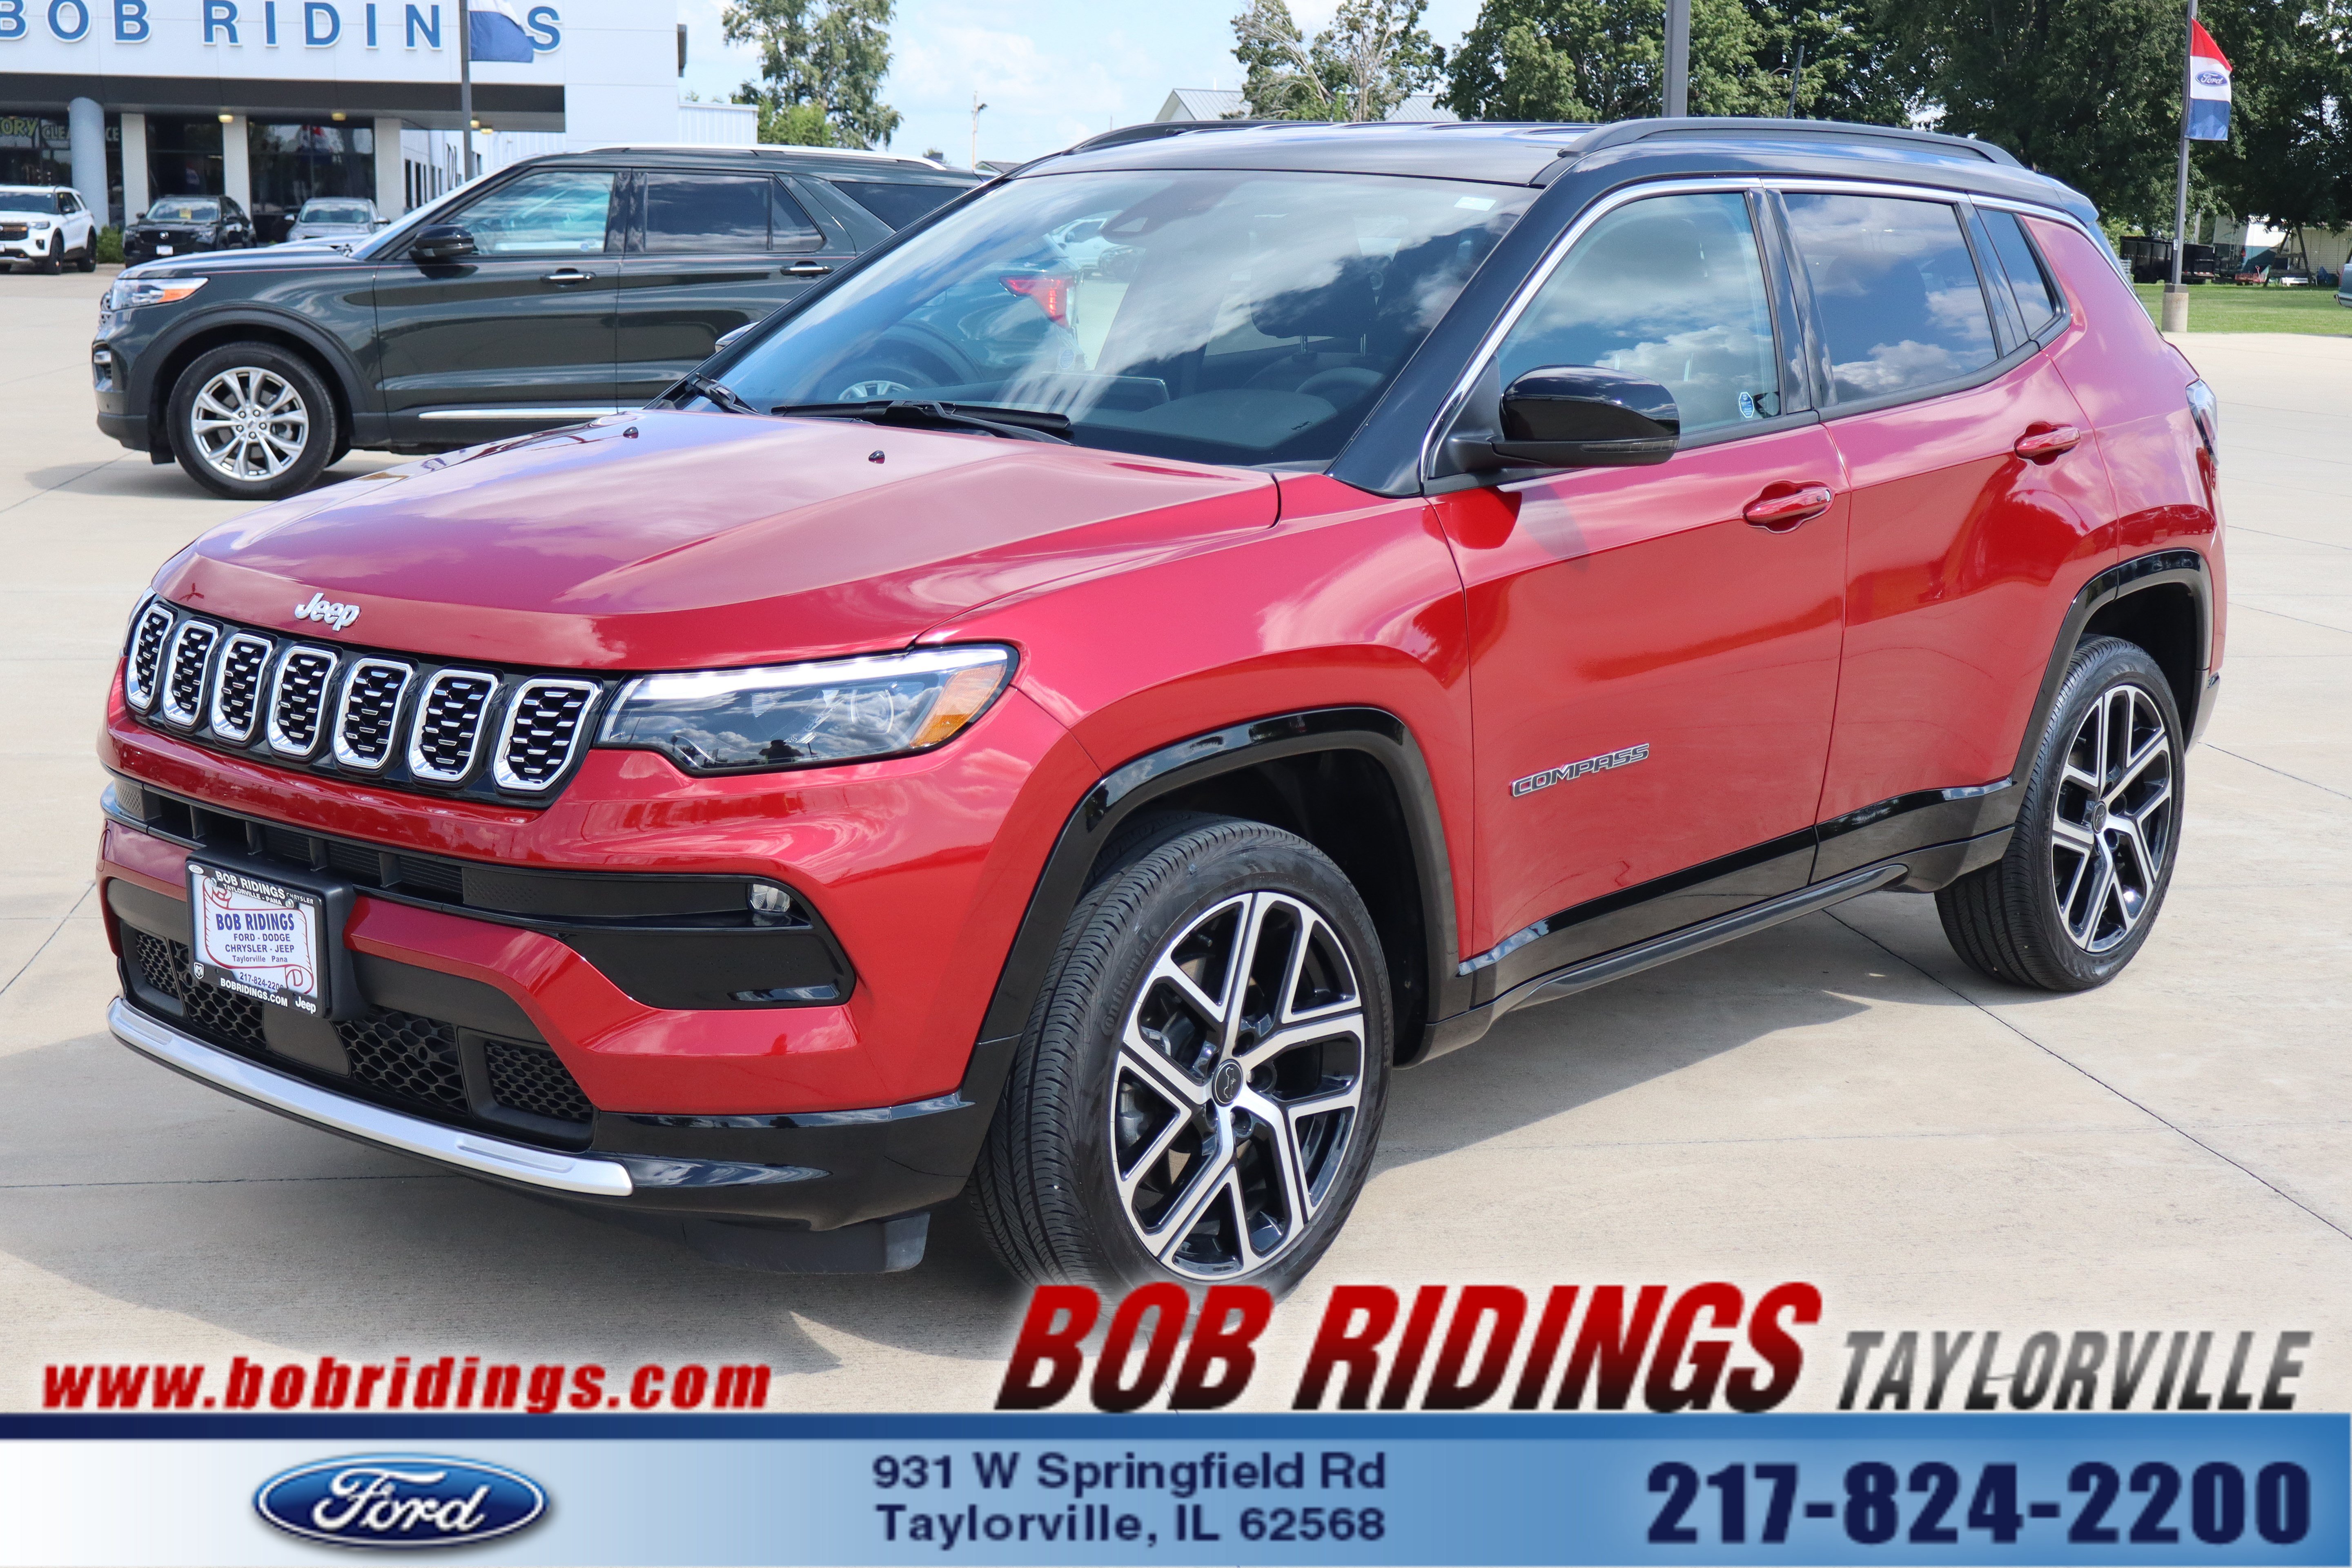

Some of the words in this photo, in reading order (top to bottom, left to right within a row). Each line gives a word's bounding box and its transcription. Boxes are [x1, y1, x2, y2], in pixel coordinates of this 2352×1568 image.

[0, 0, 151, 42] BOB
[203, 0, 561, 52] RIDINS
[2201, 72, 2224, 84] Ford
[294, 592, 360, 632] Jeep
[1512, 742, 1650, 797] COMPASS
[215, 871, 238, 886] BOB
[240, 878, 286, 900] RIDINGS
[223, 884, 261, 900] TAYLORVILLE
[266, 896, 283, 906] PANA
[287, 893, 314, 904] CHRYSLER
[216, 913, 241, 931] BOB
[245, 913, 294, 931] RIDINGS
[234, 933, 255, 942] FORD
[263, 933, 291, 942] DODGE
[225, 944, 267, 953] CHRYSLER
[275, 944, 294, 953] JEEP
[232, 955, 266, 964] Taylorville
[220, 978, 288, 1007] BOBRIDINGS.COM
[1101, 933, 1152, 1036] Continental
[295, 996, 316, 1014] Jeep
